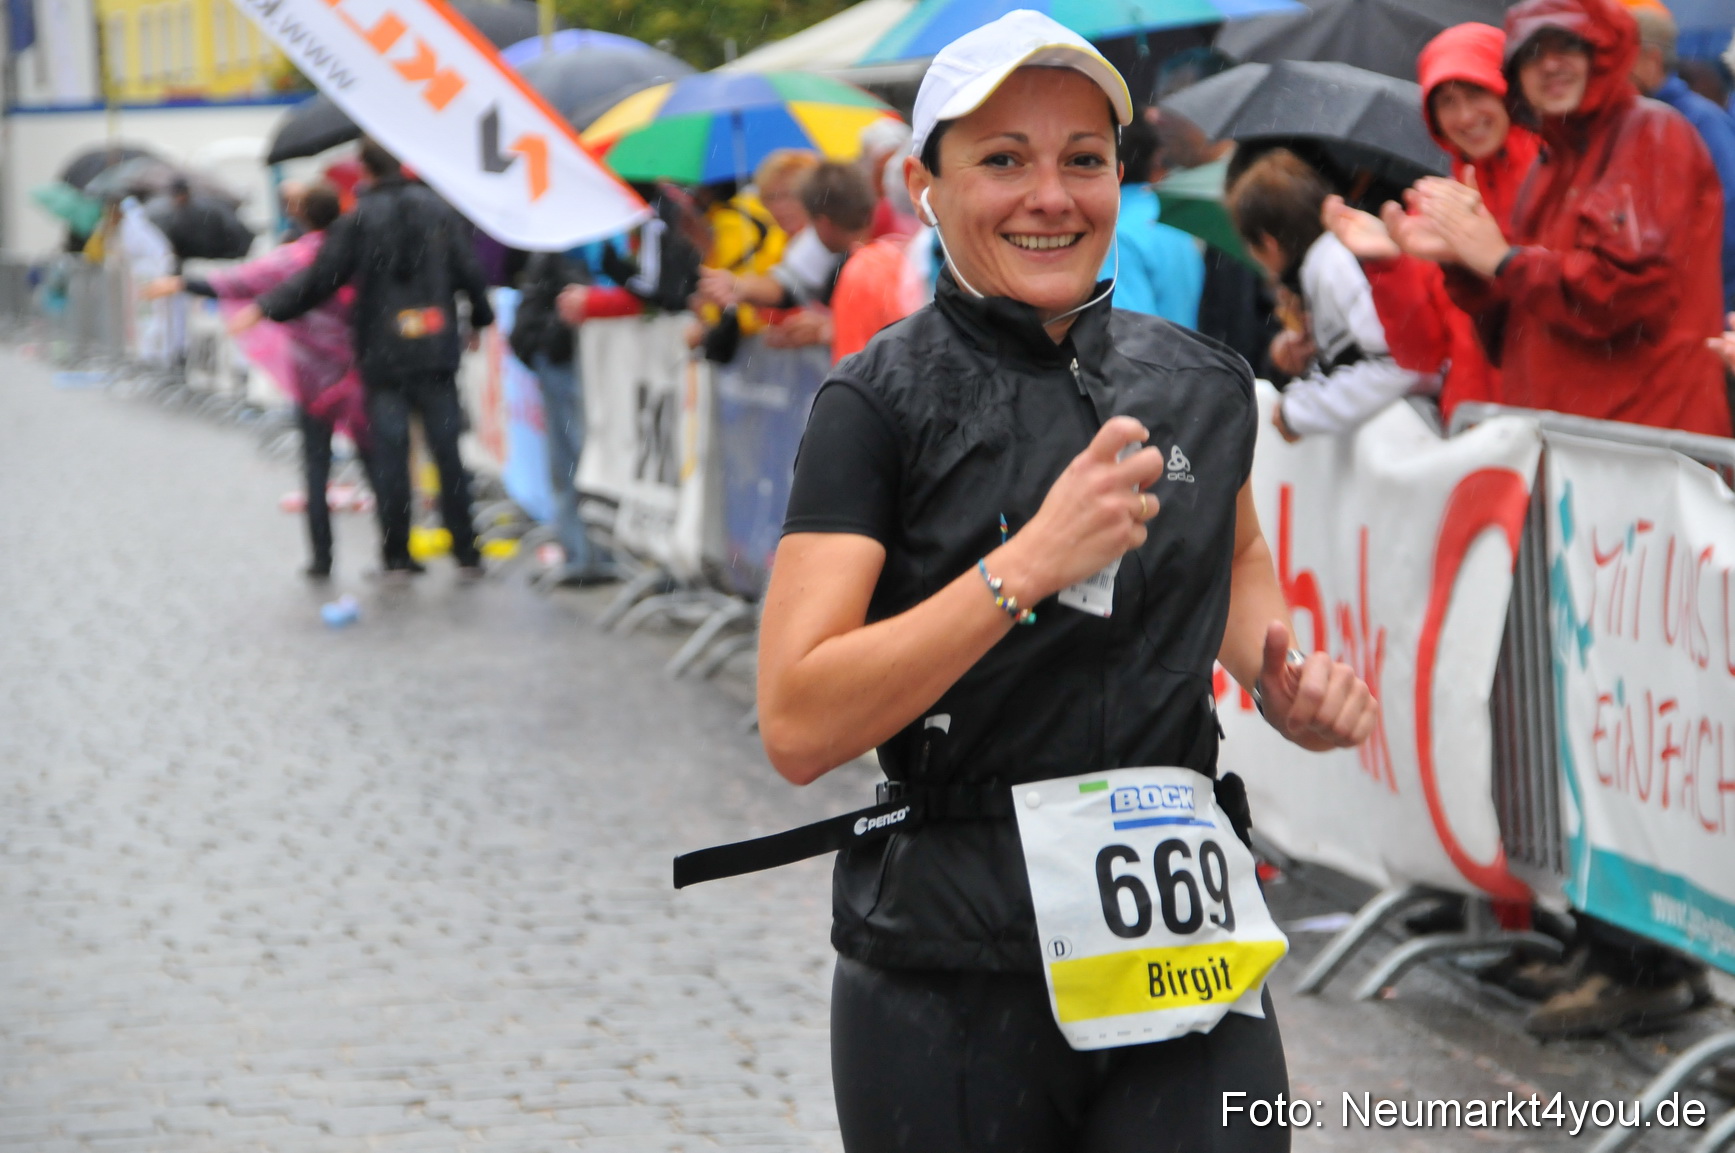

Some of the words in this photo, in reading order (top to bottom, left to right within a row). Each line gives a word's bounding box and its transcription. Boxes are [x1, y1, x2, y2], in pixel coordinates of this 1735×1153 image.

[1110, 784, 1195, 813] BOCK
[1095, 838, 1236, 939] 669
[1054, 940, 1065, 957] D
[1147, 956, 1233, 1001] Birgit
